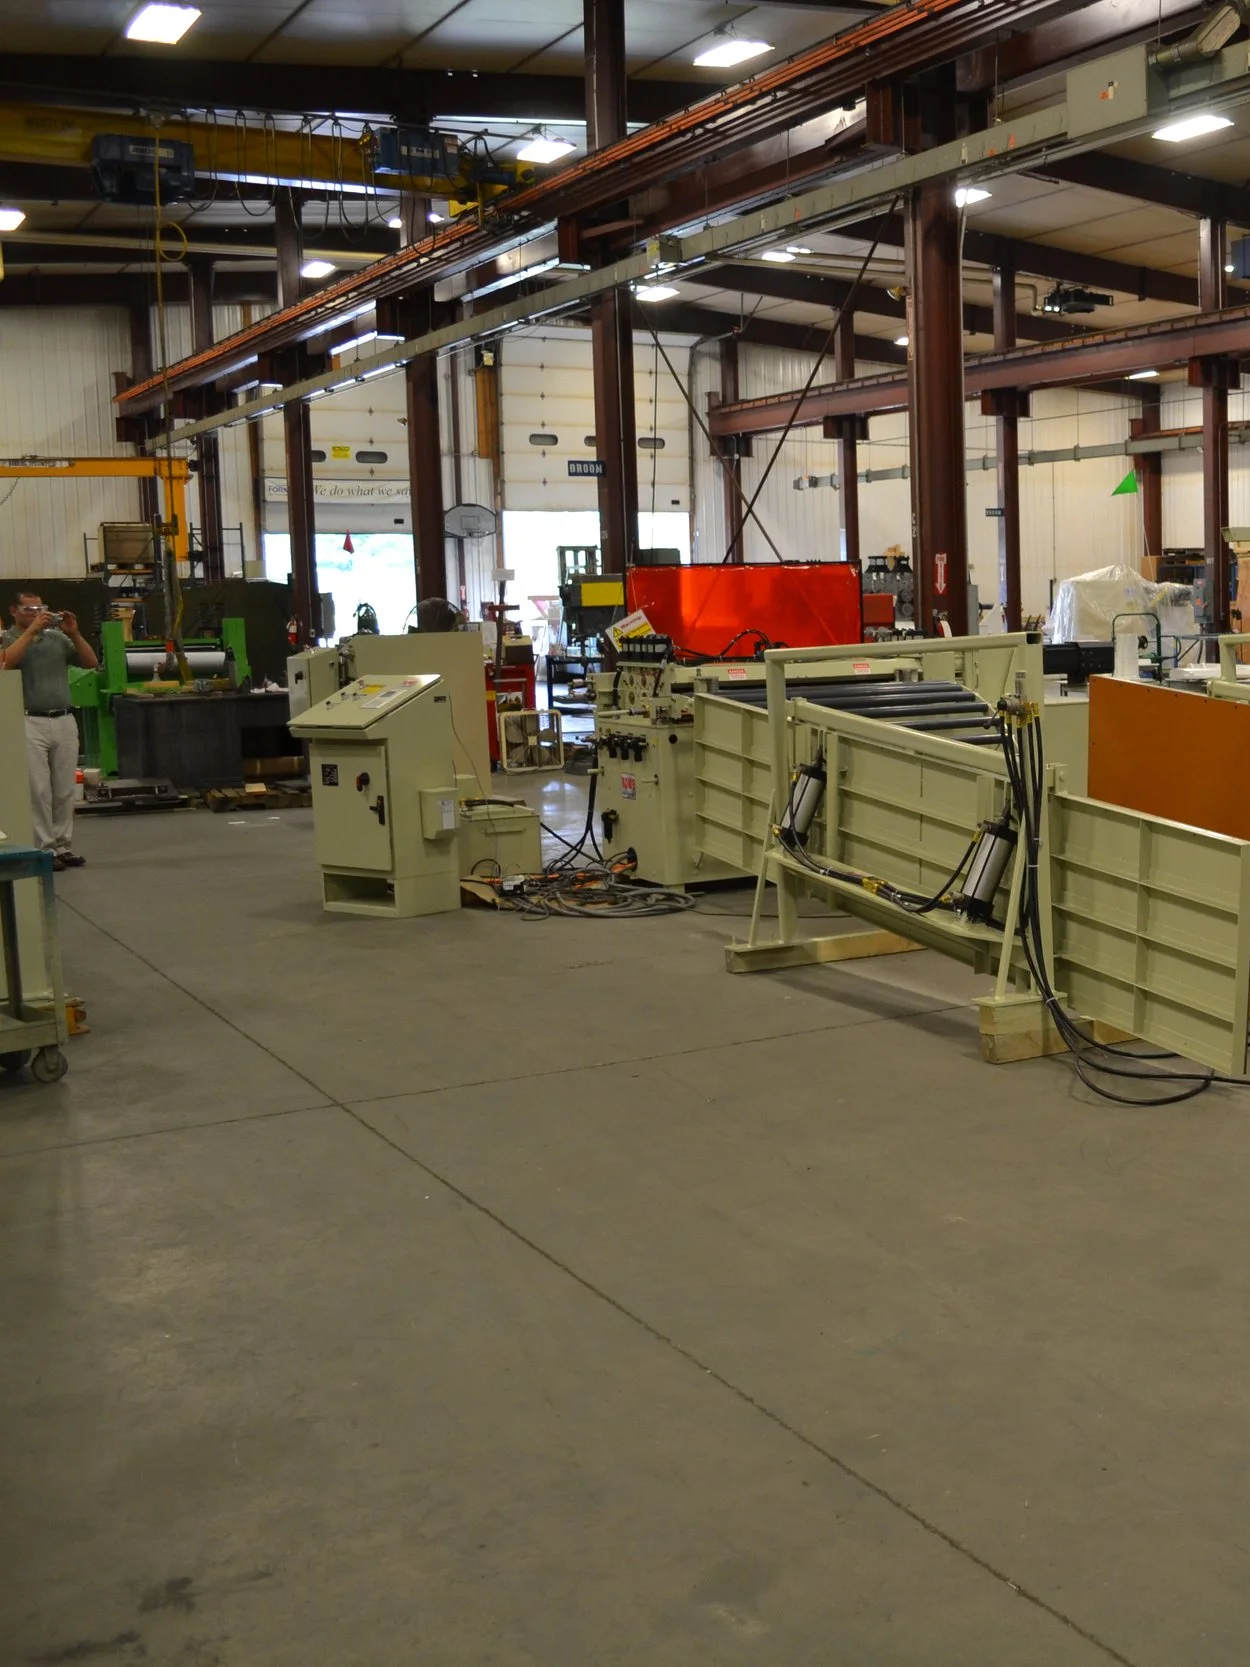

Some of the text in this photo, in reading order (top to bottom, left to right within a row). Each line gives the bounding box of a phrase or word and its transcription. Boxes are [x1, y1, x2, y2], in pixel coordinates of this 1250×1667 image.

[569, 463, 603, 474] BROOM
[329, 484, 344, 496] do
[347, 485, 375, 497] what
[378, 488, 393, 497] we
